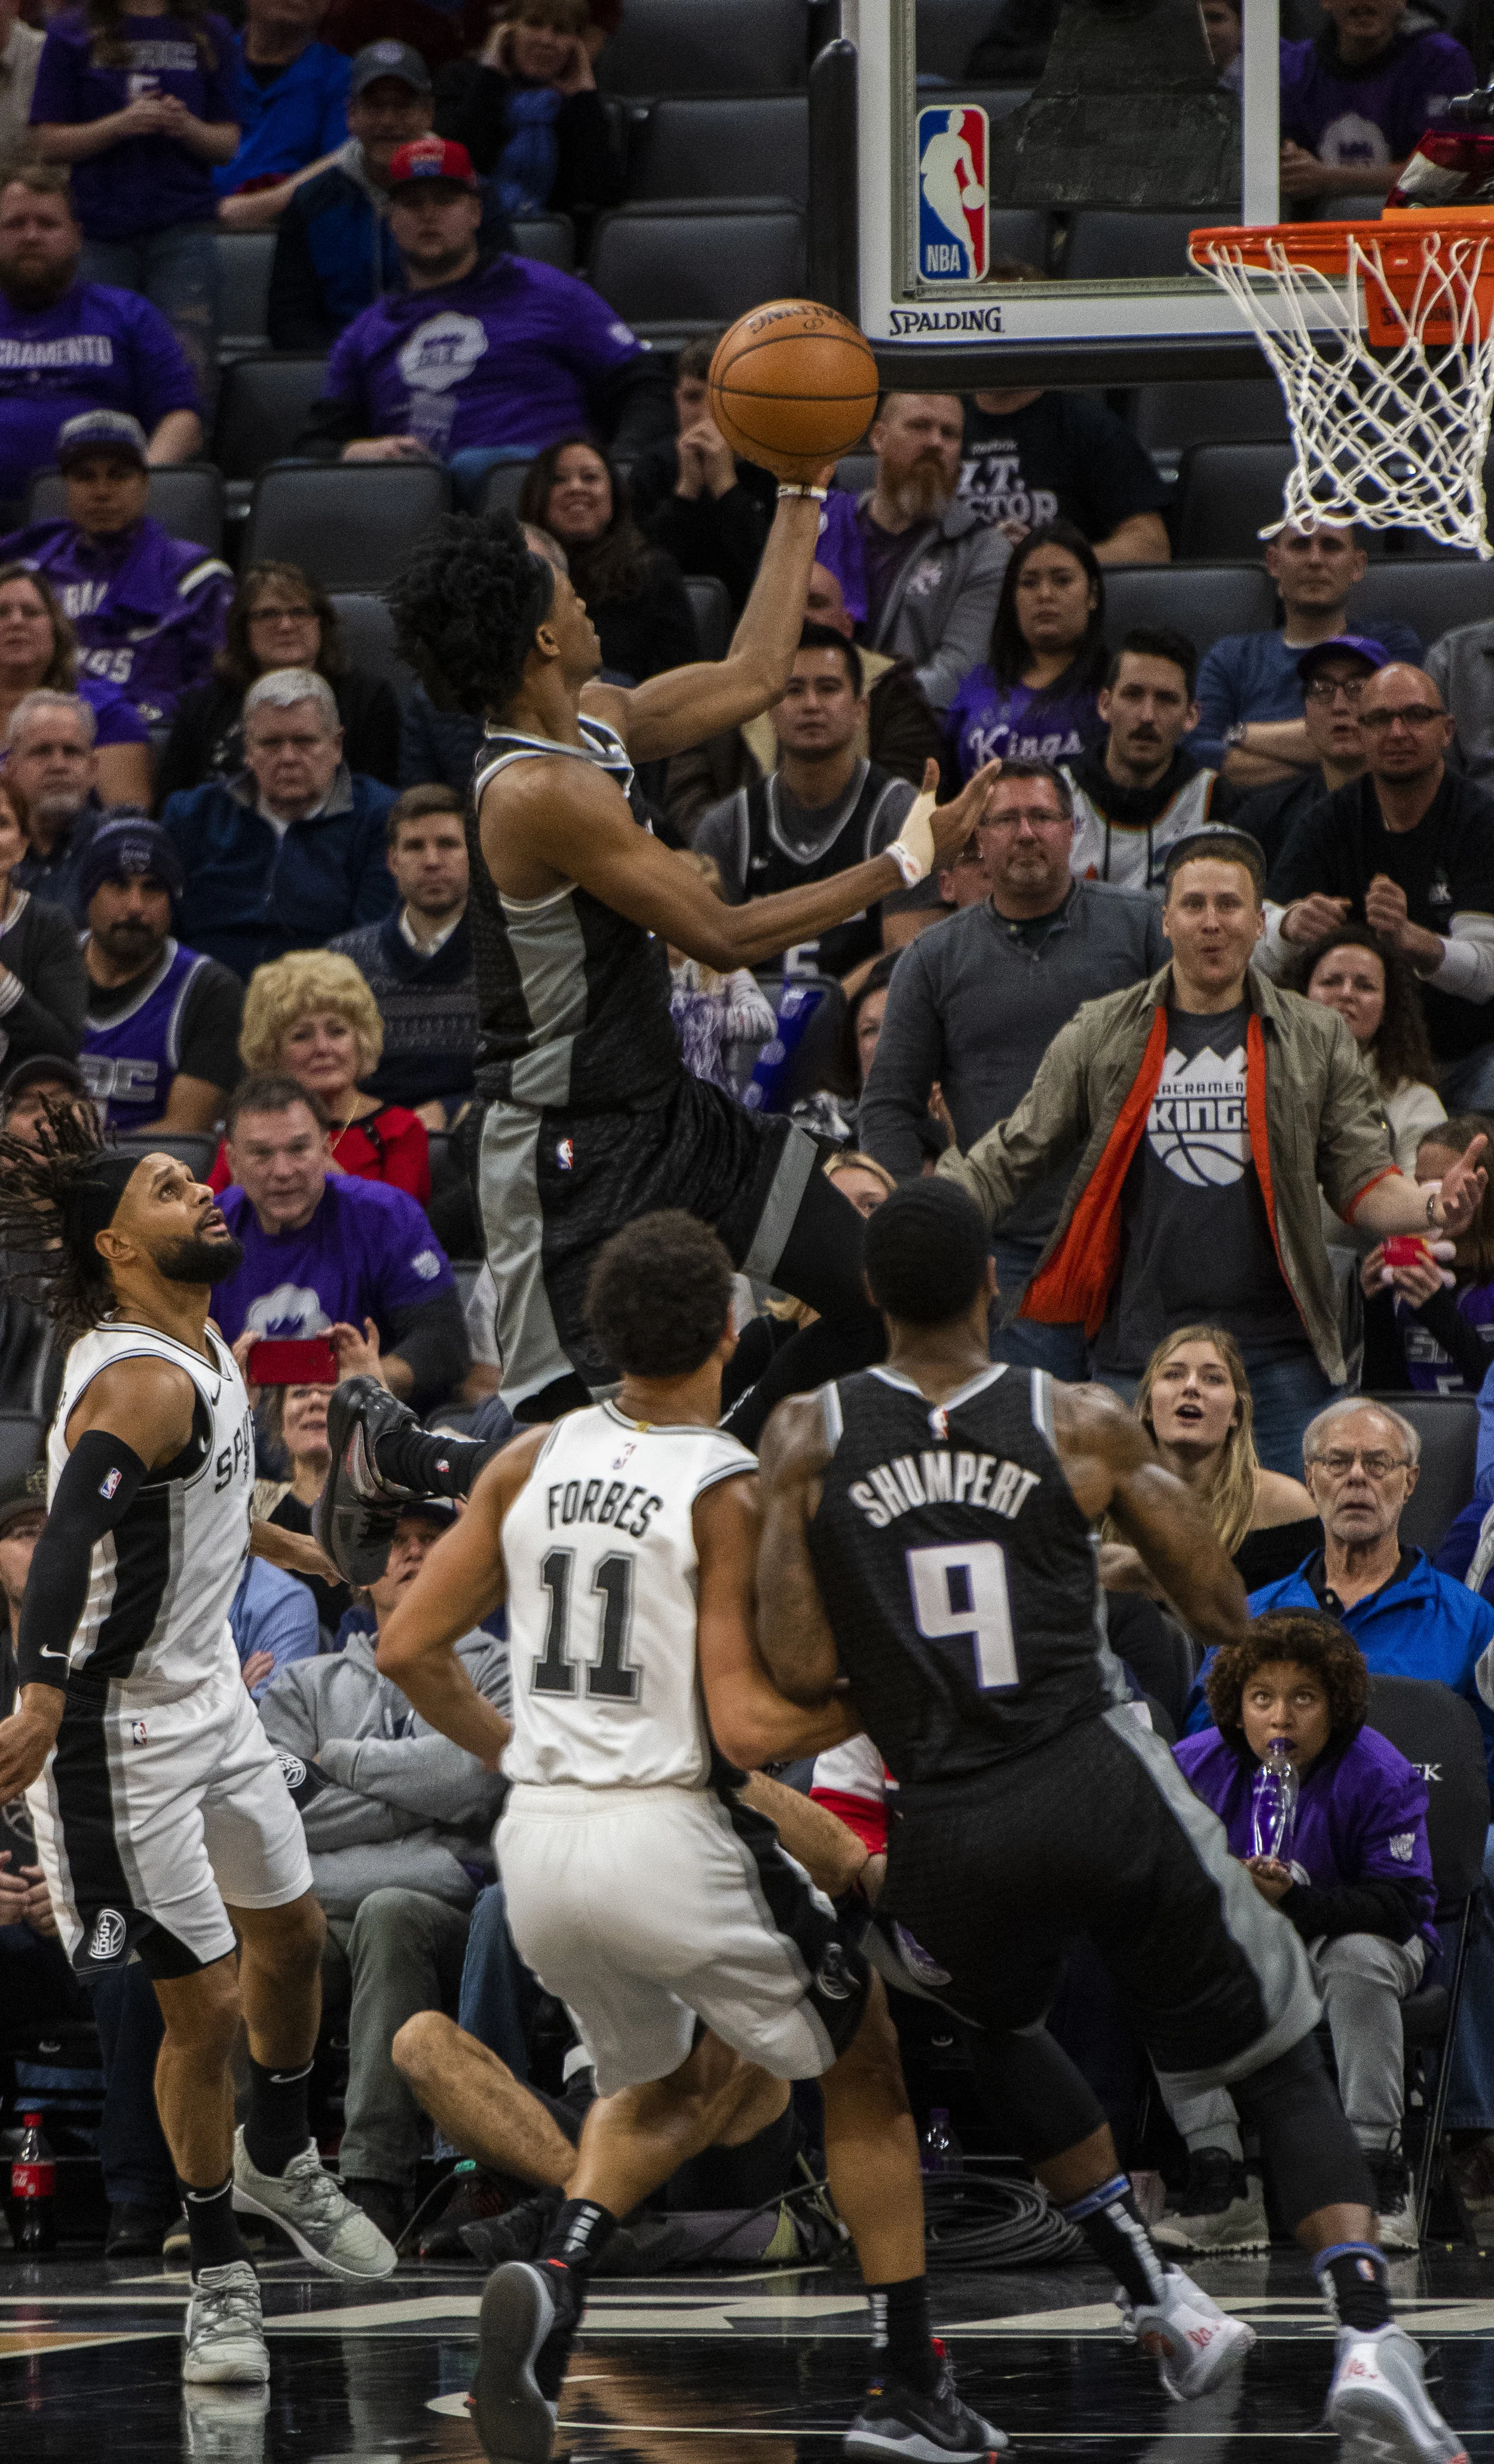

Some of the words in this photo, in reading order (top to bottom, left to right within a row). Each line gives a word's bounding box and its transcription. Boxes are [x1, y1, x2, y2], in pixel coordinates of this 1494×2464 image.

[926, 244, 961, 272] NBA
[889, 307, 1002, 336] SPALDING
[967, 724, 1085, 767] Kings
[1158, 1081, 1244, 1095] ACRAMEN
[547, 1479, 663, 1538] FORBES
[849, 1450, 1041, 1528] SHUMPERT
[530, 1545, 644, 1704] 11
[905, 1540, 1020, 1689] 9
